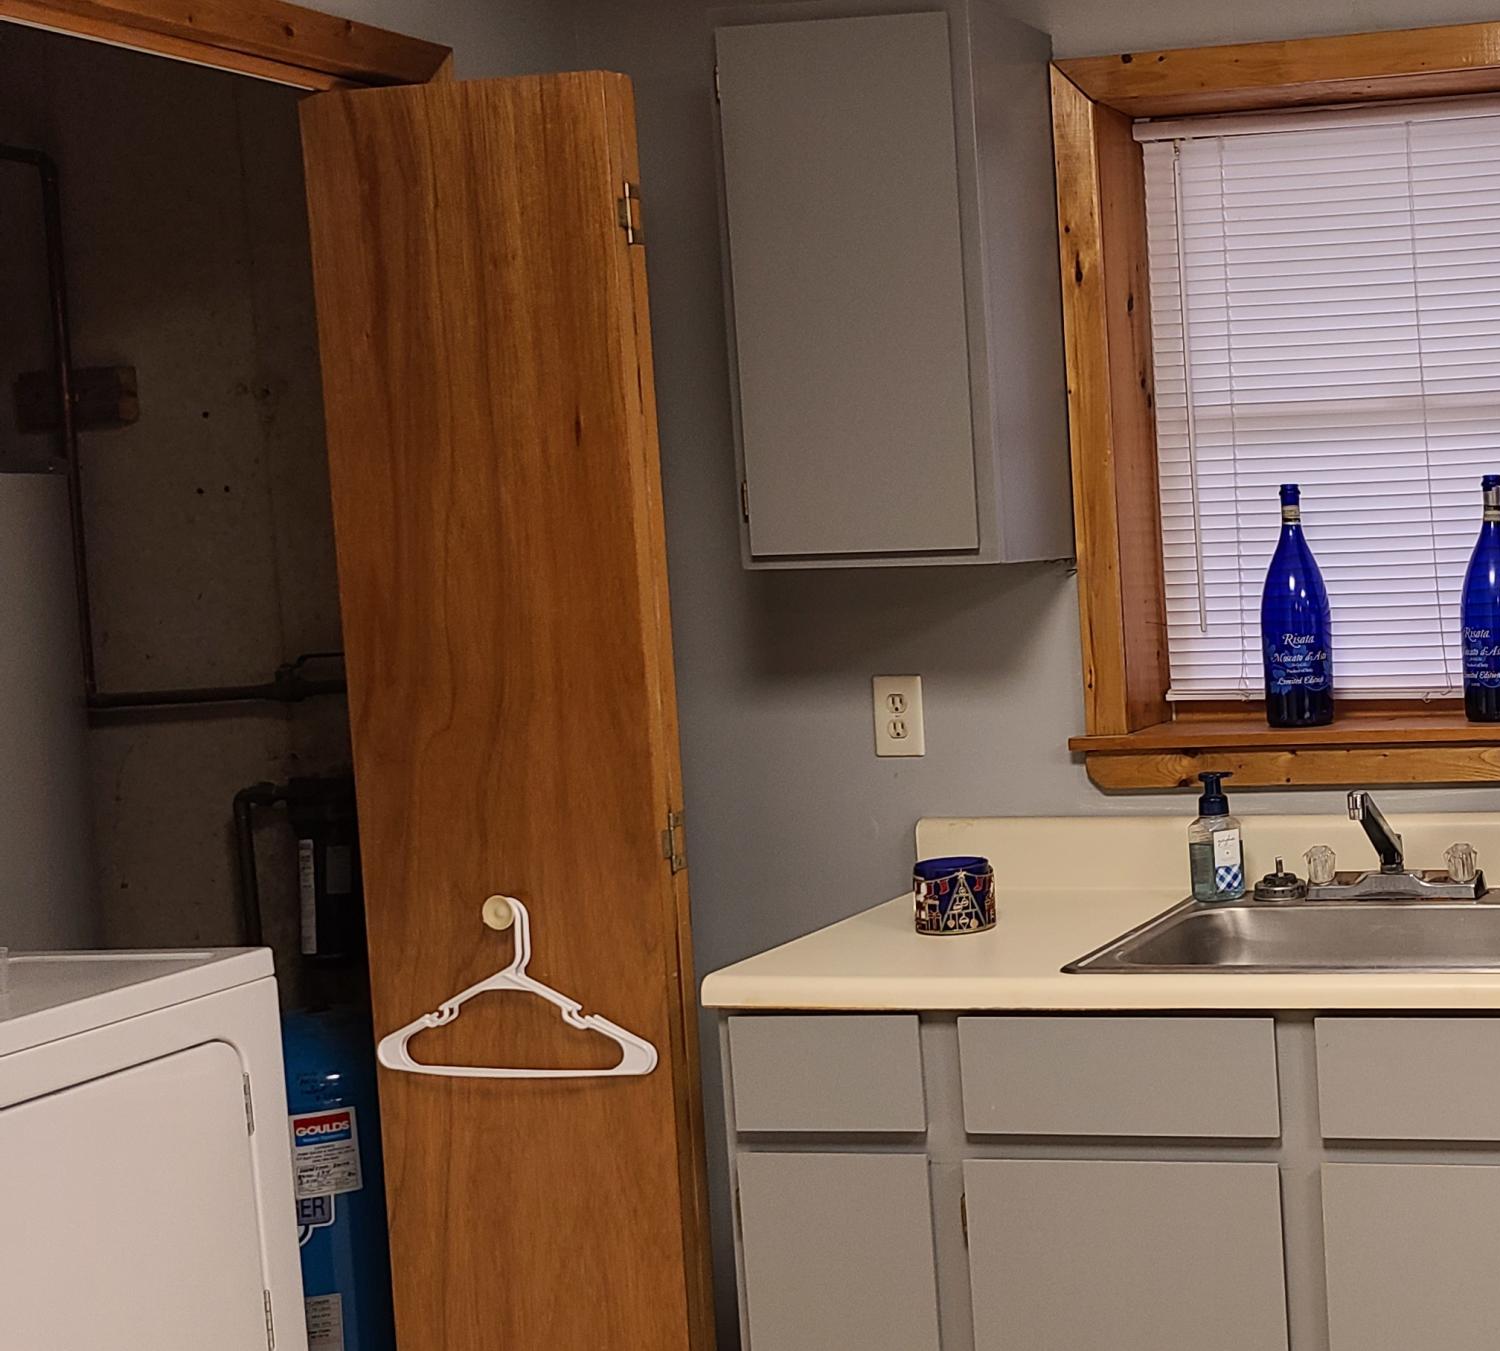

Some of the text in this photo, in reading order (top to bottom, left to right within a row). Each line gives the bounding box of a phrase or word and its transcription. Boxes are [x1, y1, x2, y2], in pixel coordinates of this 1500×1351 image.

[1282, 633, 1315, 648] Risata
[1464, 626, 1490, 642] Risata
[295, 1120, 350, 1137] GOULDS
